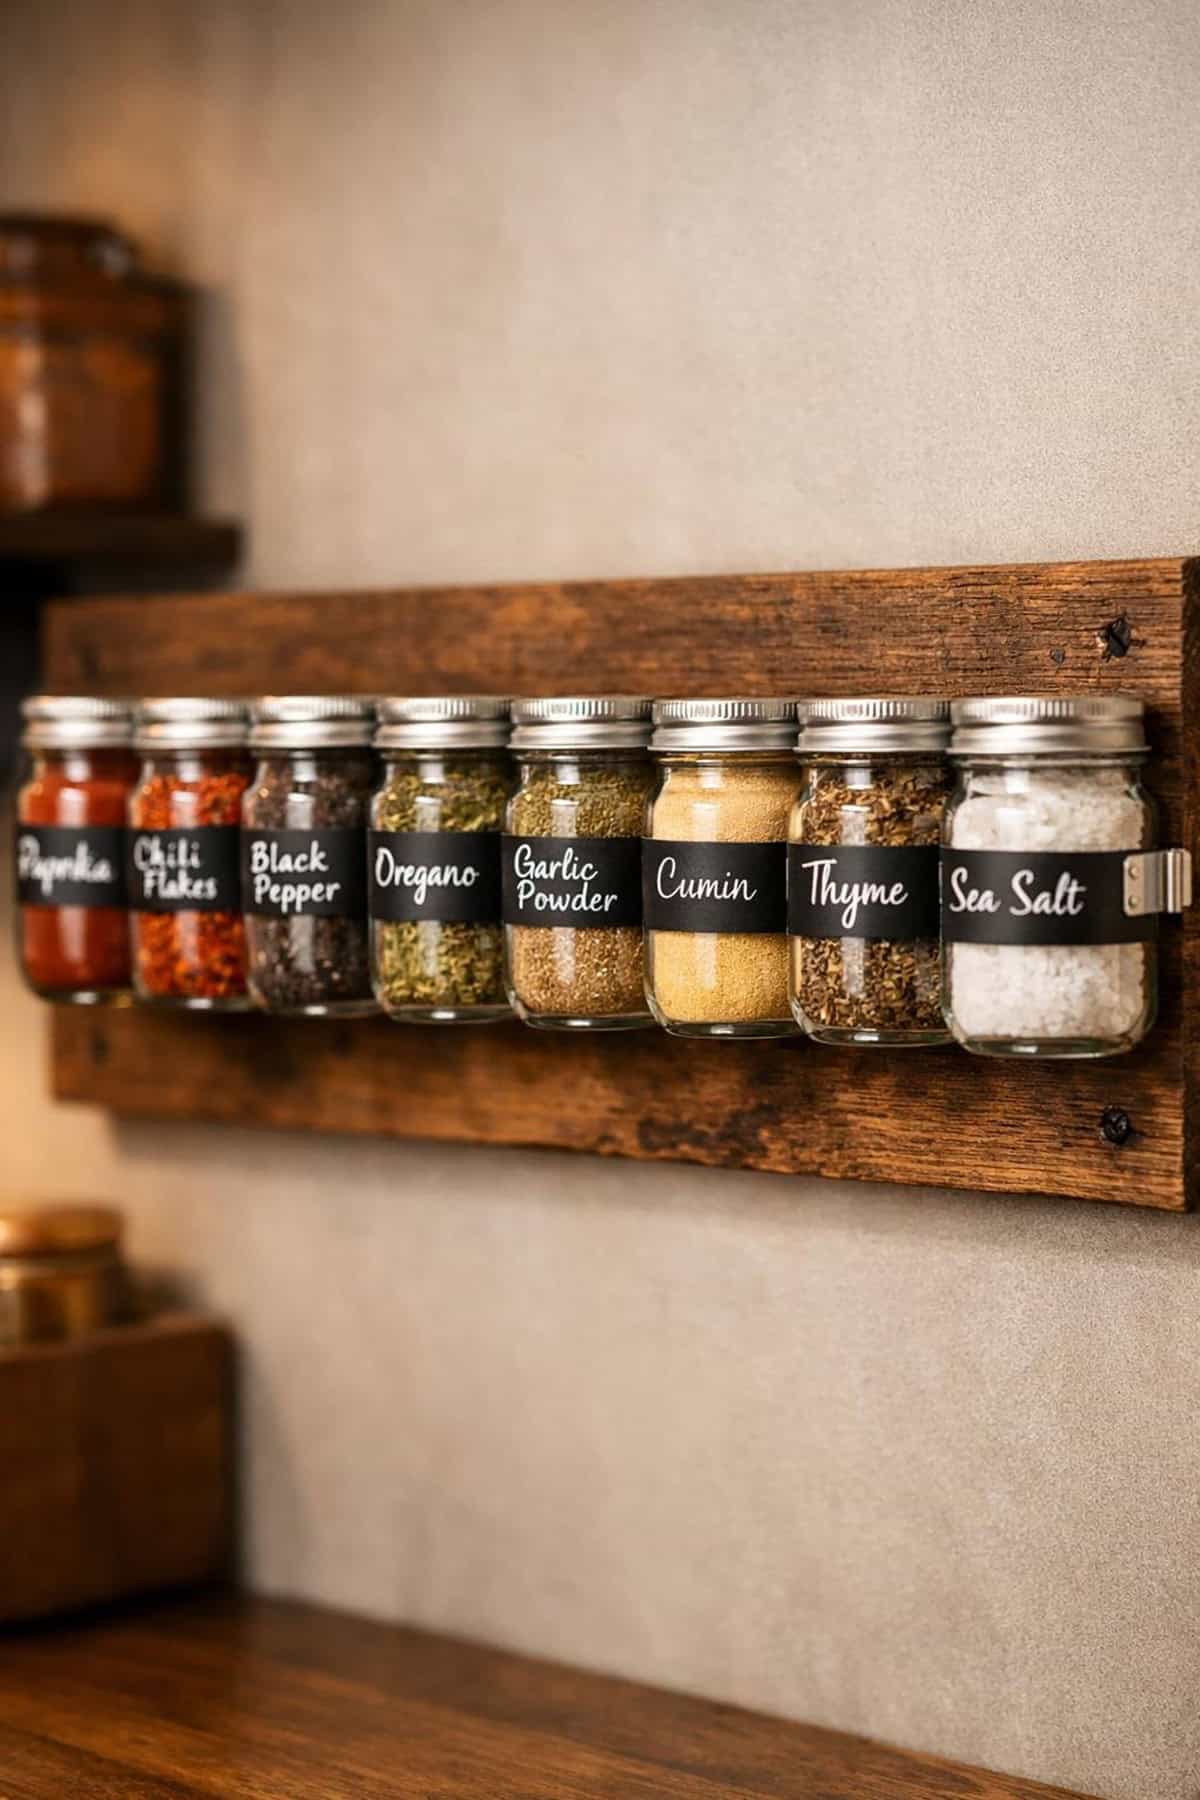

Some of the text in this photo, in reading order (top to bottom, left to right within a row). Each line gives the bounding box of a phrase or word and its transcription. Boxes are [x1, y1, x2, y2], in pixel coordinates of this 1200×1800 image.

[134, 835, 201, 871] Chili
[251, 840, 329, 874] Black
[514, 844, 599, 880] Garlic
[143, 867, 218, 899] Flakes
[254, 873, 341, 913] Pepper
[375, 847, 480, 905] Oregano
[656, 856, 758, 901] Cumin
[801, 858, 909, 930] Thyme
[949, 866, 1087, 917] Sea Salt
[517, 879, 618, 912] Powder
